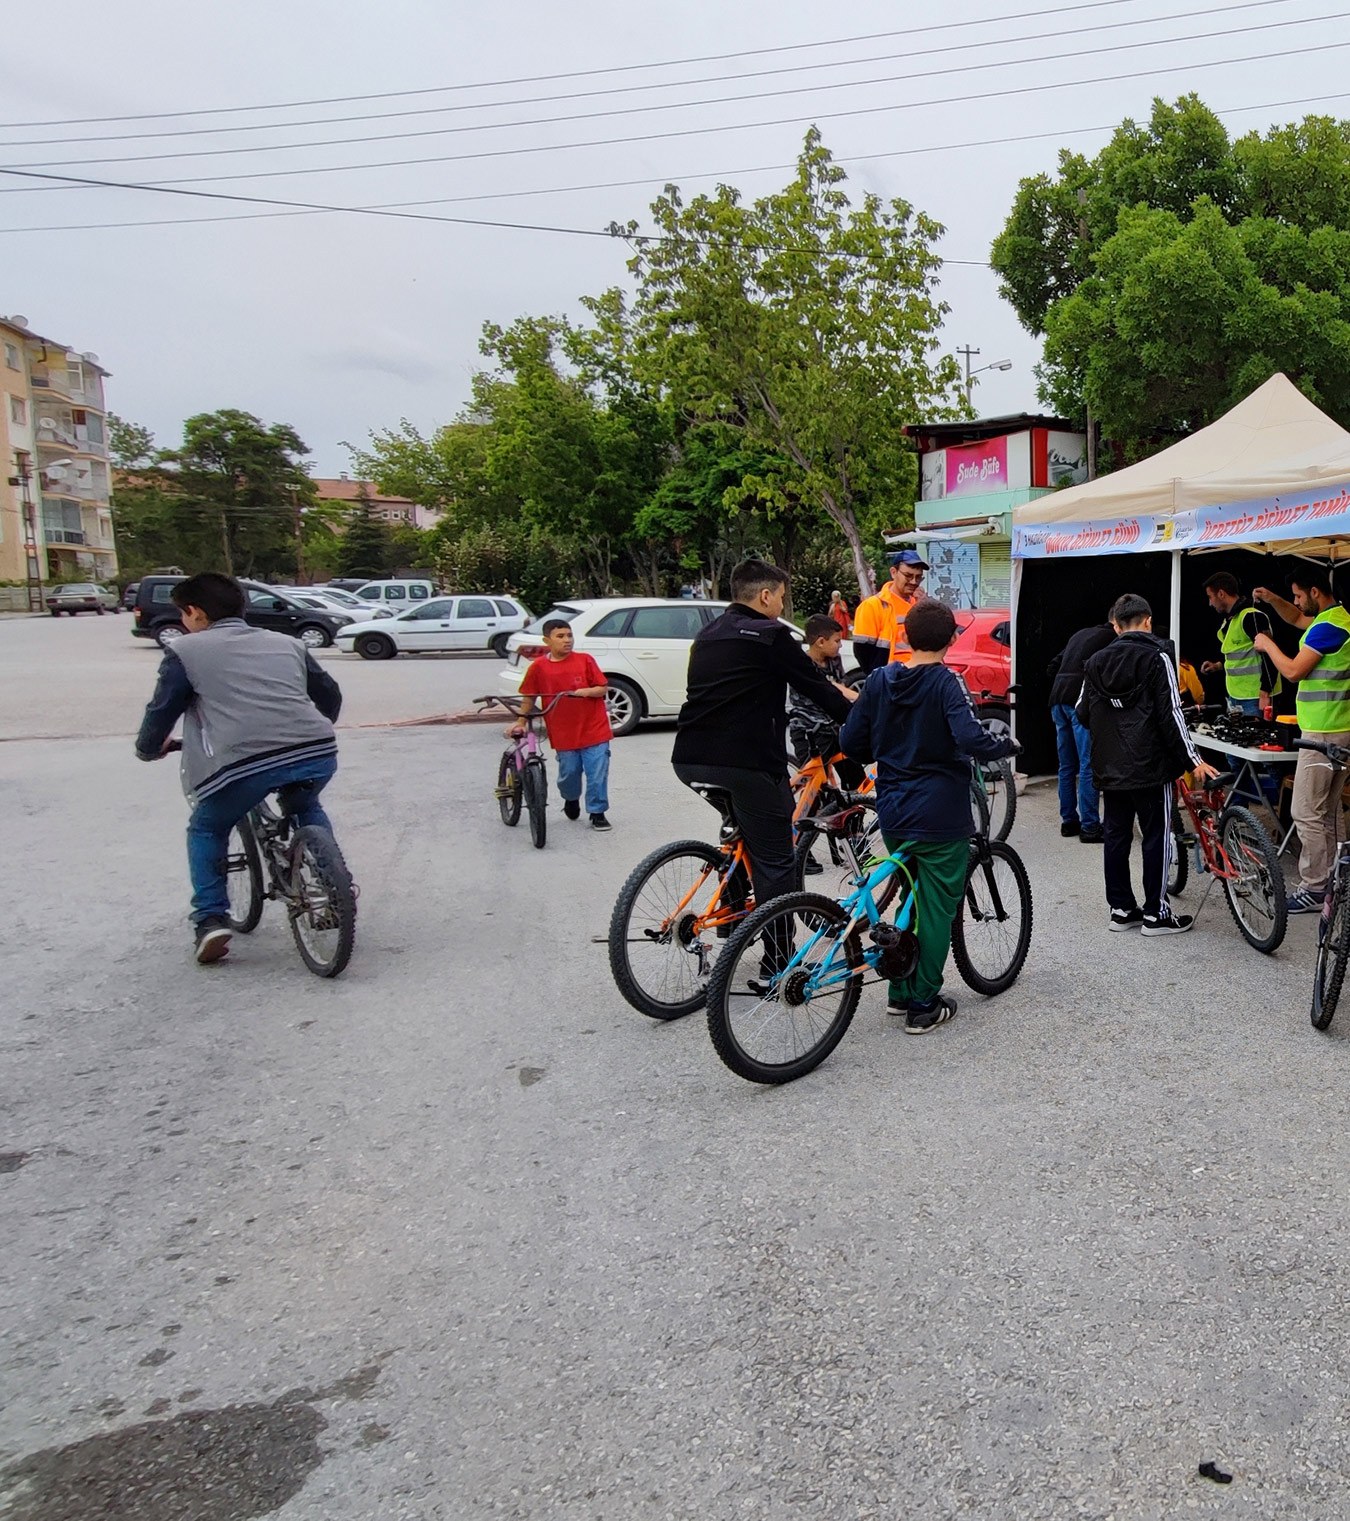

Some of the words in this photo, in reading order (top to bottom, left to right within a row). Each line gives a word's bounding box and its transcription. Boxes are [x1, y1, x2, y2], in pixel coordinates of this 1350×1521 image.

[957, 461, 978, 484] Sude
[980, 456, 1000, 481] Büfe
[1045, 532, 1074, 554] DÜNYA
[1070, 527, 1112, 550] BİSİKLET
[1111, 520, 1140, 546] GÜNÜ
[1198, 513, 1254, 542] ÜCRETSİZ
[1250, 506, 1309, 532] BİSİKLET
